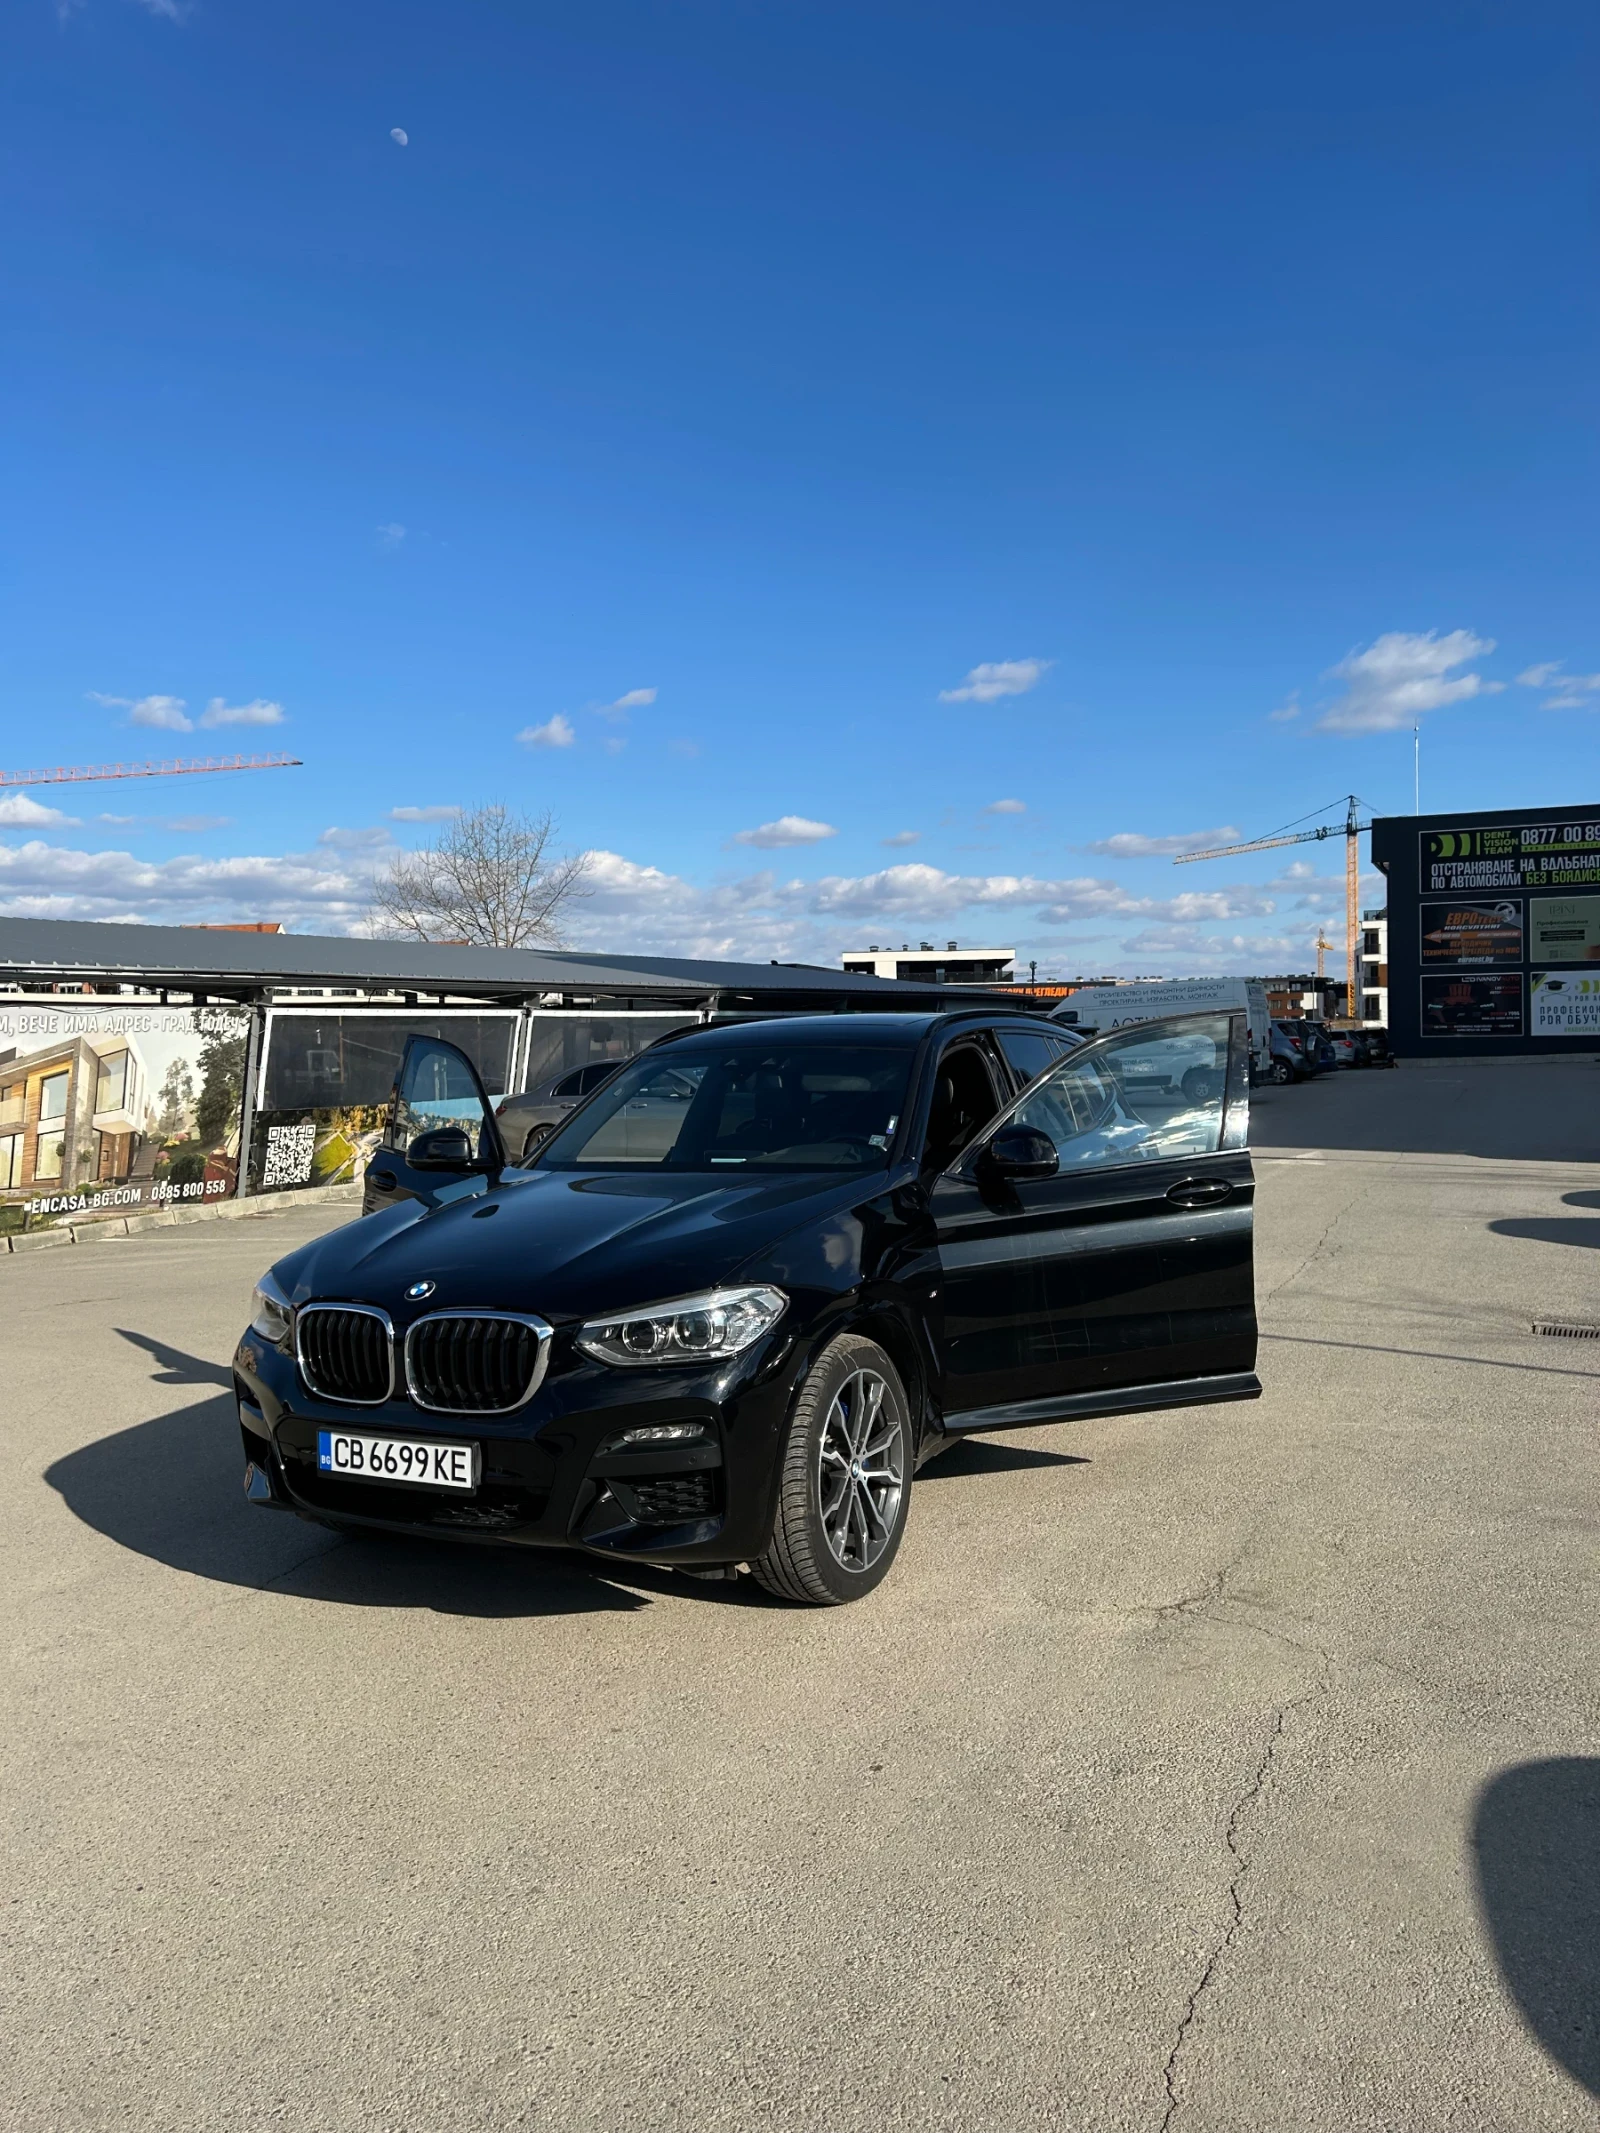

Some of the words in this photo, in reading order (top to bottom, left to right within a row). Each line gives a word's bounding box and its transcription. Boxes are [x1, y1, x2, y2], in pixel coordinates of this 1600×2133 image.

[1484, 831, 1512, 839] DENT
[1484, 838, 1518, 846] VISION
[1521, 828, 1557, 845] 0877
[1563, 826, 1582, 842] 00
[1484, 846, 1512, 854] TEAM
[1431, 859, 1515, 876] ОТСТРАНЯВАНЕ
[1520, 858, 1535, 872] НА
[1431, 876, 1445, 889] ПО
[1450, 872, 1521, 888] АВТОМОБИЛИ
[1526, 871, 1547, 885] БЕЗ
[1093, 989, 1142, 999] СТРОИТЕЛСТВО
[1150, 986, 1186, 996] РЕМОНТНИ
[1187, 984, 1225, 993] ДЕЙНОСТИ
[1188, 991, 1220, 1000] МОНТАЖ
[18, 1015, 58, 1033] ВЕЧЕ
[64, 1014, 98, 1033] ИМА
[104, 1014, 151, 1035] АДРЕС
[162, 1014, 196, 1034] ГРАД
[200, 1014, 240, 1033] ГОДЕЧ
[151, 1184, 181, 1200] 0885
[182, 1181, 204, 1197] 800
[206, 1179, 226, 1195] 558
[321, 1455, 331, 1464] BG
